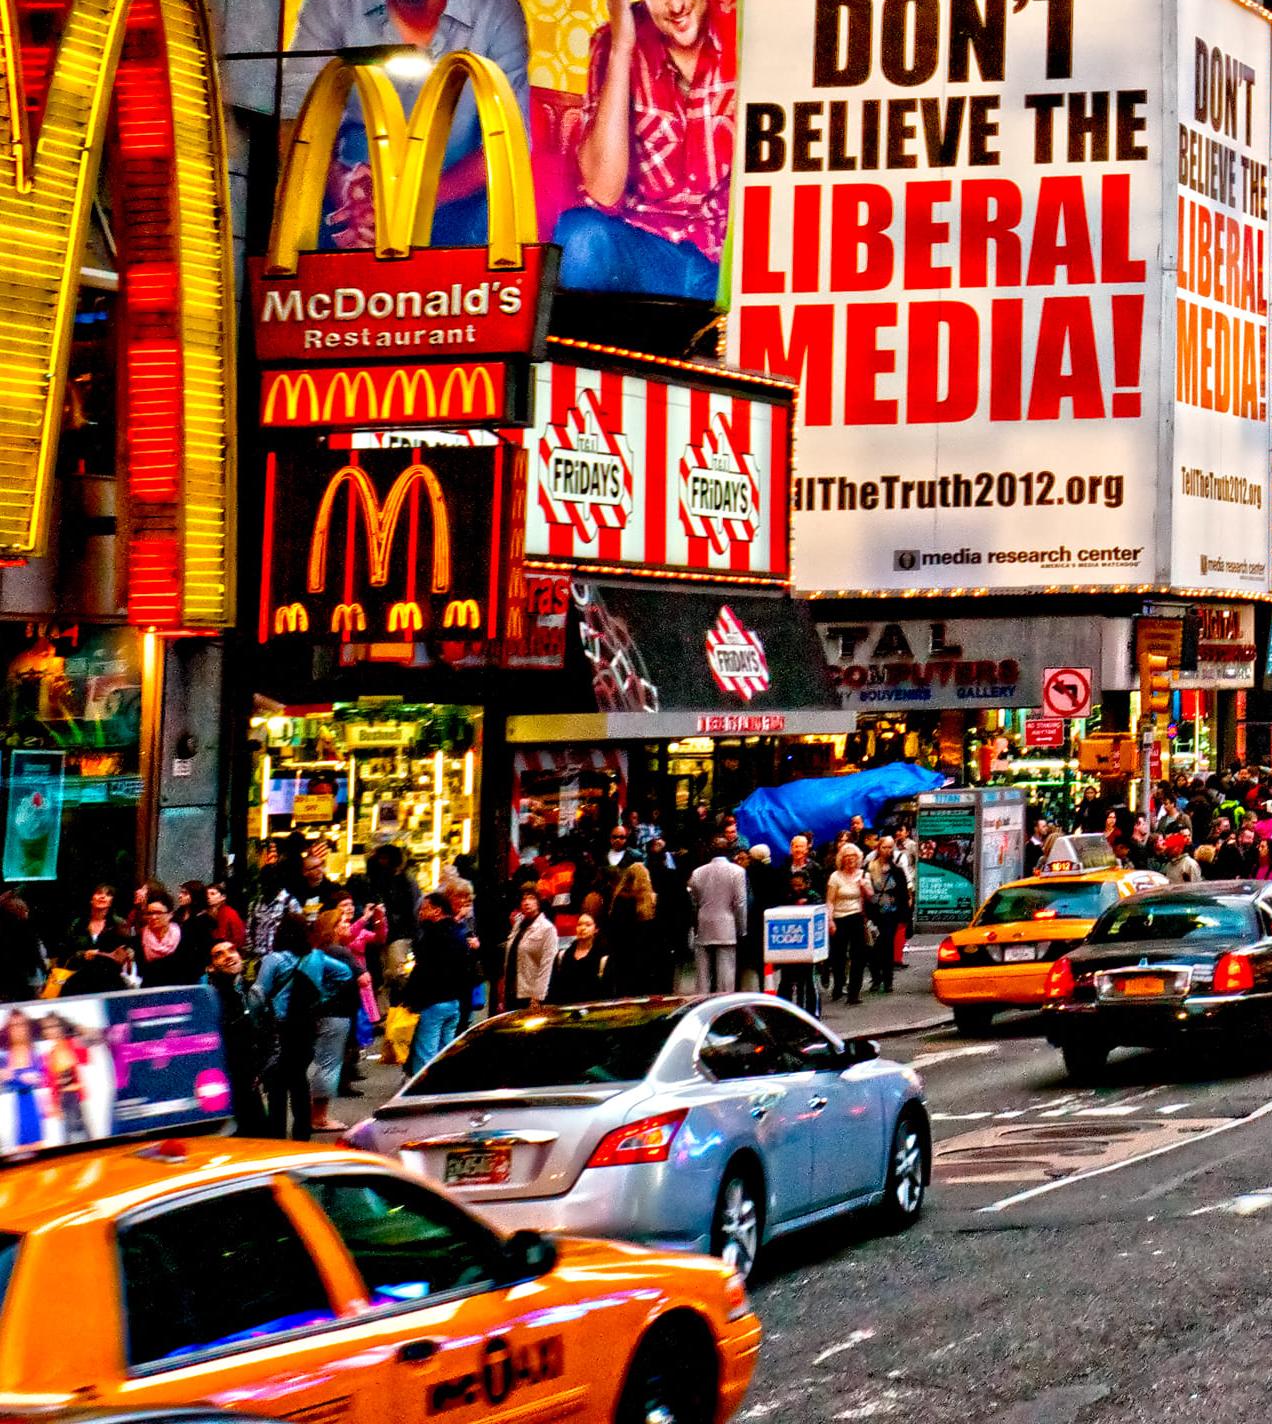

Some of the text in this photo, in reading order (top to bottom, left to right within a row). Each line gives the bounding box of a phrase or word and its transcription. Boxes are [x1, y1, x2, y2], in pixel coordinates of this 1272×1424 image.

[1194, 36, 1256, 147] DON'T
[744, 88, 1149, 174] BELIEVE THE
[1178, 122, 1269, 222] BELIEVE THE
[739, 173, 1148, 295] LIBERAL
[1176, 194, 1269, 312] LIBERAL
[259, 279, 522, 325] McDonald's
[302, 322, 478, 350] Restaurant
[739, 294, 1146, 428] MEDIA!
[1176, 298, 1269, 424] MEDIA!
[1180, 465, 1262, 512] TellTheTruth2012.org
[921, 544, 1142, 566] media research center
[1208, 558, 1224, 572] media
[1226, 560, 1248, 574] research
[956, 685, 1016, 699] GALLERY
[770, 934, 806, 944] TODAY
[783, 924, 803, 935] USA
